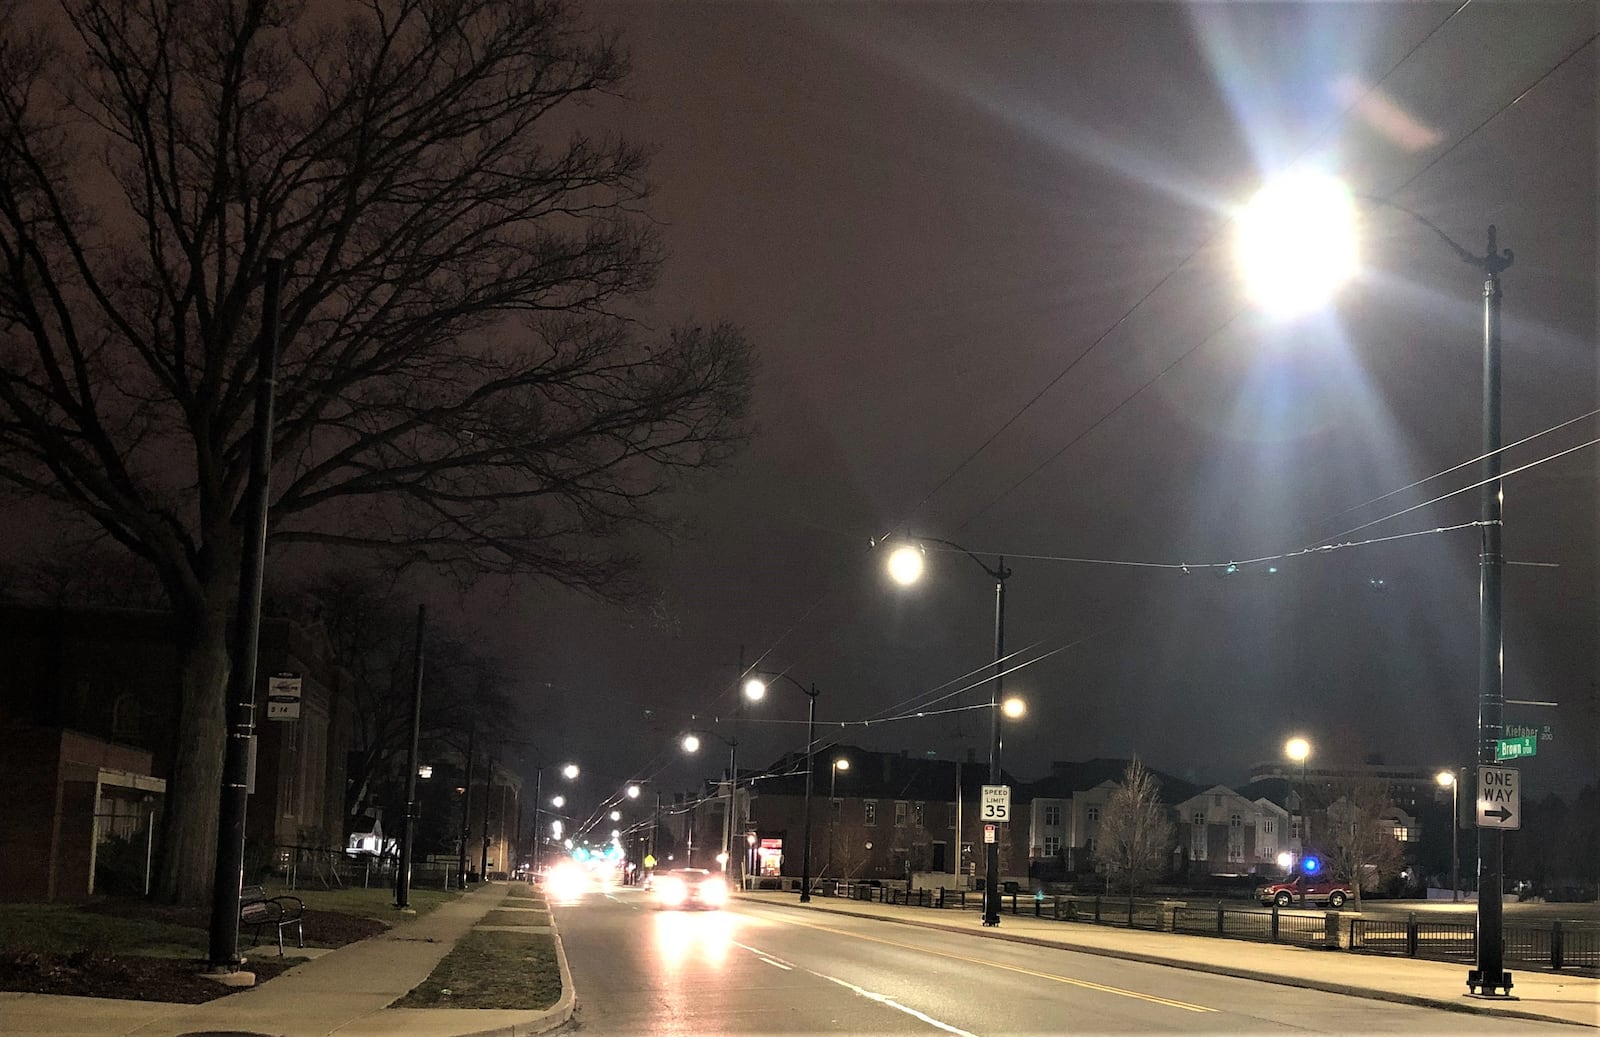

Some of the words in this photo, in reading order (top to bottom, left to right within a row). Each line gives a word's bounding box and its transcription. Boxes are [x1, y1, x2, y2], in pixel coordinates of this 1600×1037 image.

[1506, 724, 1538, 738] Kiefaber
[1502, 741, 1521, 756] Brown
[1485, 771, 1513, 786] ONE
[1484, 788, 1513, 803] WAY
[985, 805, 1006, 817] 35
